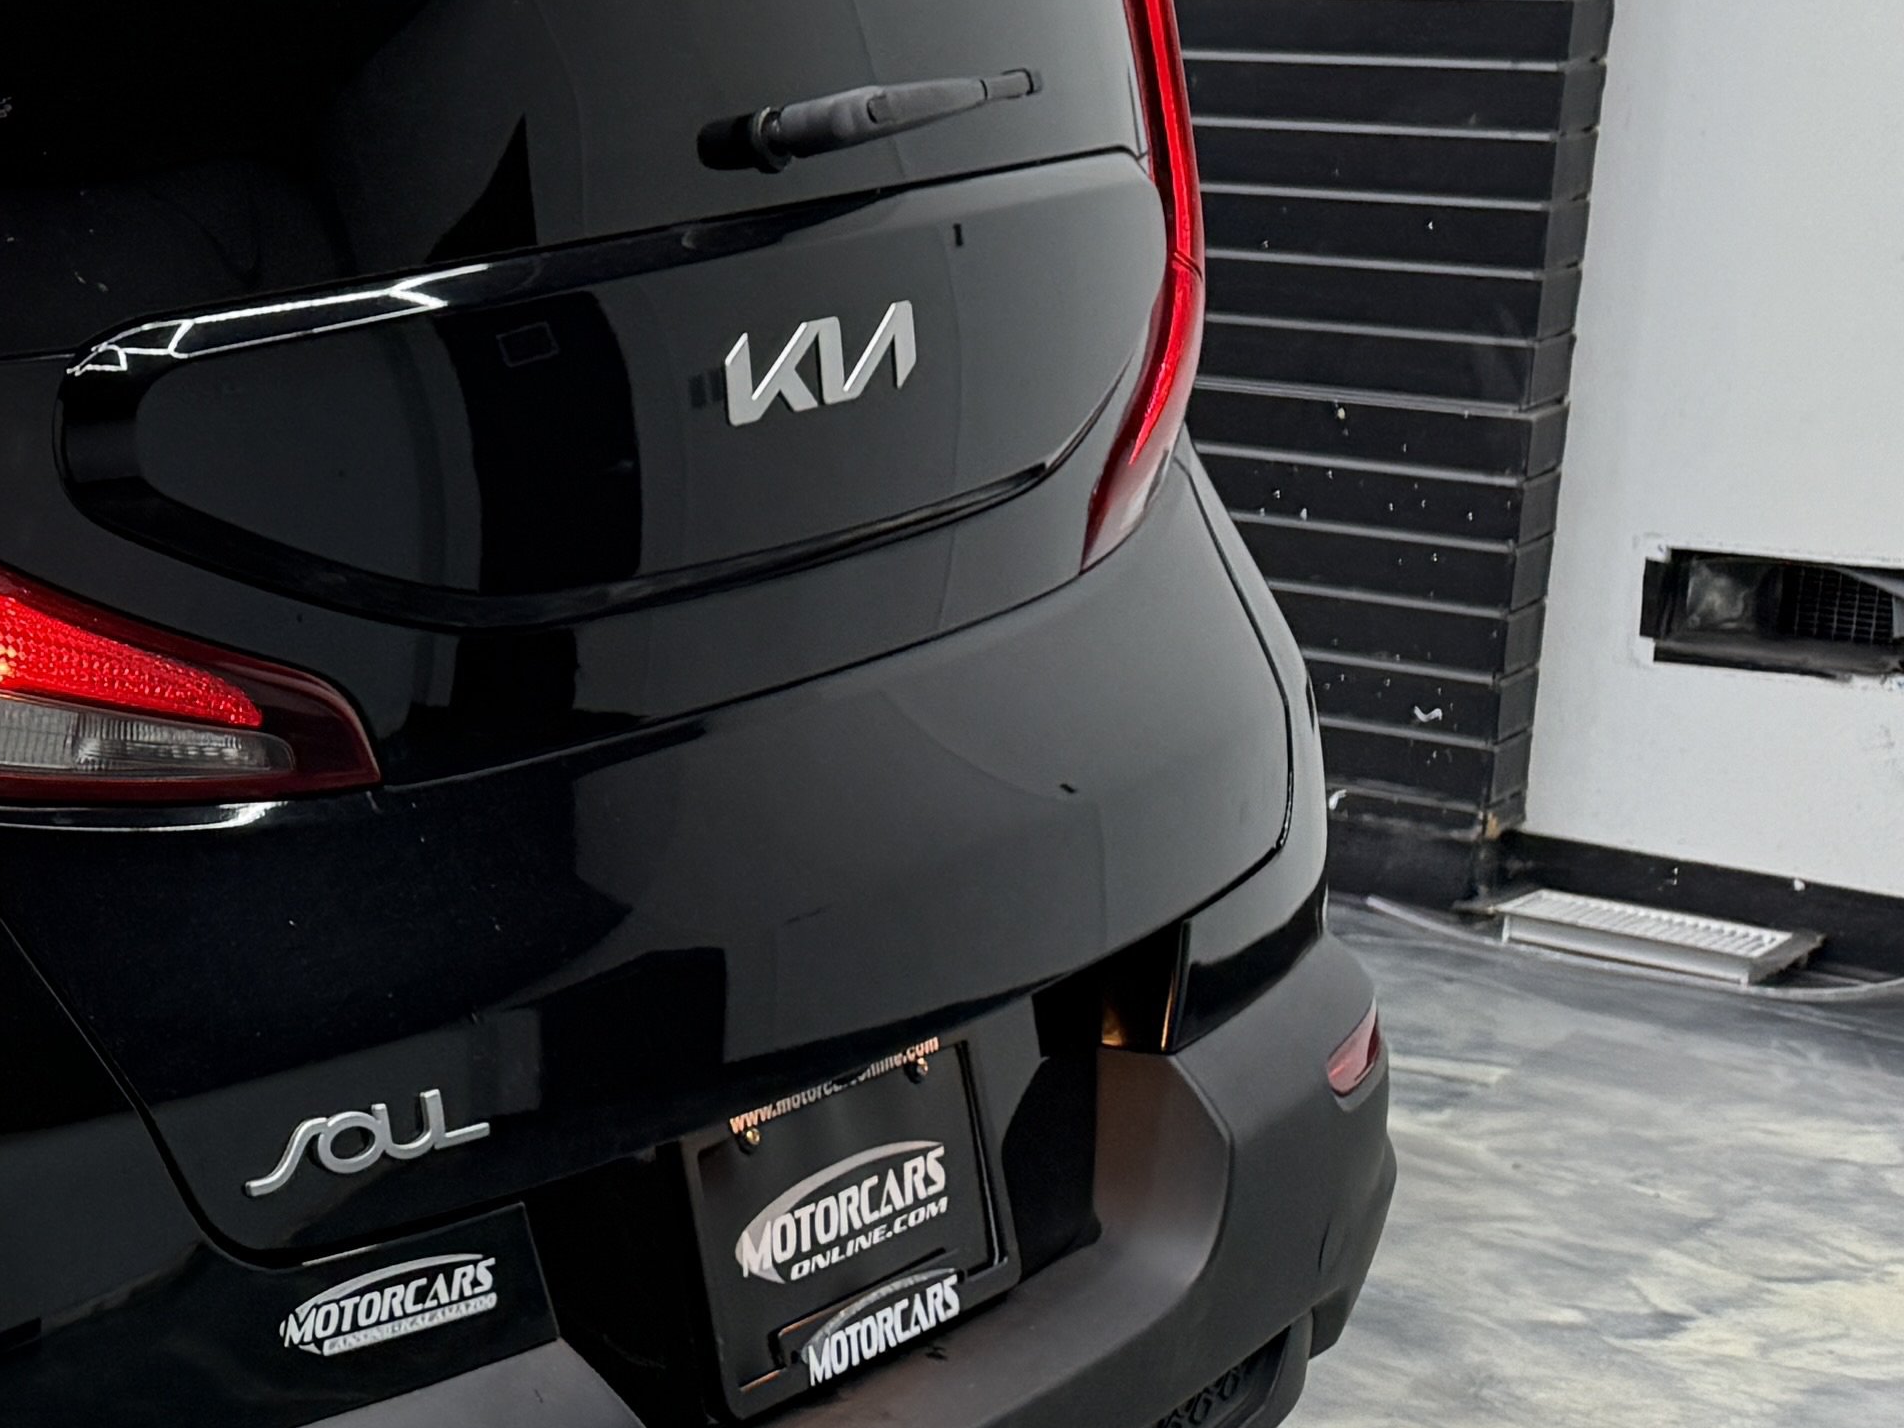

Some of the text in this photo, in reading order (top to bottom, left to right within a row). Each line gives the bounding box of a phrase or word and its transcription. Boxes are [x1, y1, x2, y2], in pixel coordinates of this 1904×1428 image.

[725, 300, 917, 427] KIA
[245, 1088, 490, 1197] SOUL
[742, 1145, 947, 1278] MOTORCARS
[790, 1196, 949, 1281] ONLINE.COM
[284, 1257, 496, 1347] MOTORCARS
[808, 1274, 961, 1387] MOTORCARS
